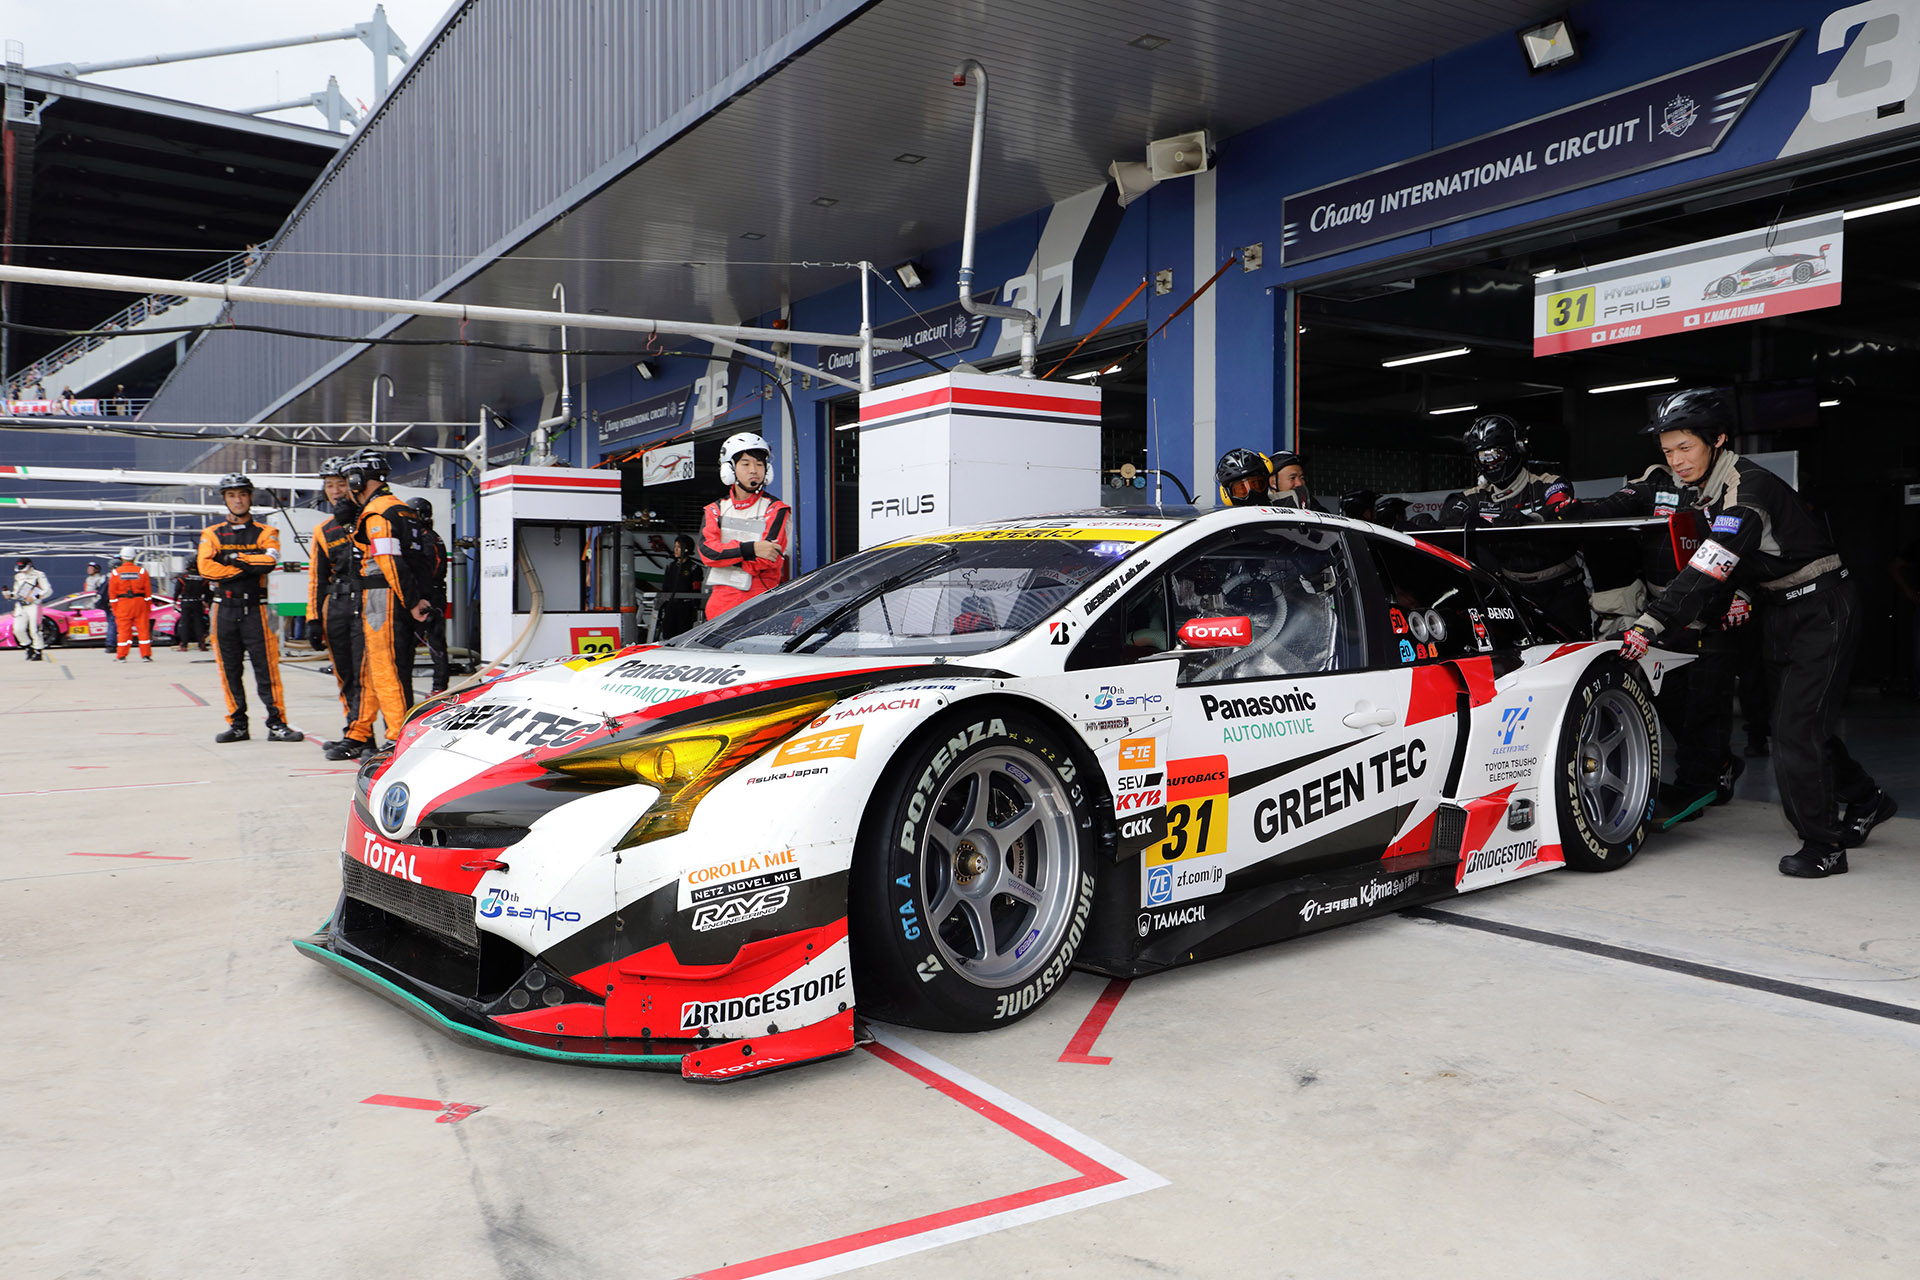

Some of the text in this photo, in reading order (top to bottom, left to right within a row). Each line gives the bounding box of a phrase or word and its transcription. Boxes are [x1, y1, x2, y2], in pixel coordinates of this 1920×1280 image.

[1310, 118, 1640, 233] Chang INTERNATIONAL CIRCUIT
[1003, 261, 1073, 339] 37
[1553, 293, 1588, 326] 31
[1604, 296, 1671, 318] PRIUS
[1703, 302, 1765, 324] Y.NAKAYAMA
[1609, 325, 1641, 340] K.SAGA
[828, 324, 948, 371] Chang CIRCUIT
[694, 370, 728, 419] 36
[604, 407, 668, 432] Chang INTERNATIONAL CIRCUIT
[683, 461, 693, 478] 88
[871, 494, 935, 519] PRIUS
[1425, 503, 1443, 511] TOY
[1680, 536, 1700, 549] TOT
[1785, 589, 1803, 600] SEV
[1487, 607, 1514, 619] DENSO
[1185, 626, 1243, 638] TOTAL
[604, 660, 746, 685] Panasonic
[834, 698, 920, 720] TAMACHI
[1116, 693, 1162, 712] sanko
[1202, 687, 1316, 721] Panasonic
[508, 711, 602, 748] TEC
[817, 733, 850, 748] TE
[1222, 718, 1315, 744] AUTOMOTIVE
[1137, 745, 1151, 758] TE
[1485, 757, 1537, 772] TOYOTA TSUSHO
[1489, 768, 1531, 782] ELECTRONICS
[901, 718, 1008, 855] POTENZA
[1118, 775, 1143, 791] SEV
[1167, 771, 1225, 786] AUTOBACS
[1253, 738, 1427, 843] GREEN TEC
[1116, 789, 1161, 811] KYB
[1568, 760, 1608, 860] POTENZA
[1122, 817, 1152, 839] CKK
[1162, 799, 1213, 860] 31
[364, 831, 422, 884] TOTAL
[688, 848, 798, 885] COROLLA MIE
[1466, 839, 1538, 874] BRIDGESTONE
[694, 870, 798, 901] NETZ NOVEL MIE
[1151, 874, 1169, 897] ZF
[1177, 864, 1222, 888] zf.com/jp
[507, 907, 581, 931] sanko
[695, 889, 788, 926] RAYS
[701, 906, 777, 931] ENGINEERING
[899, 899, 920, 940] GTA
[1154, 905, 1205, 930] TAMACHI
[993, 871, 1095, 1020] BRIDGESTONE
[683, 966, 846, 1028] BRIDGESTONE
[711, 1056, 784, 1075] TOTAL
